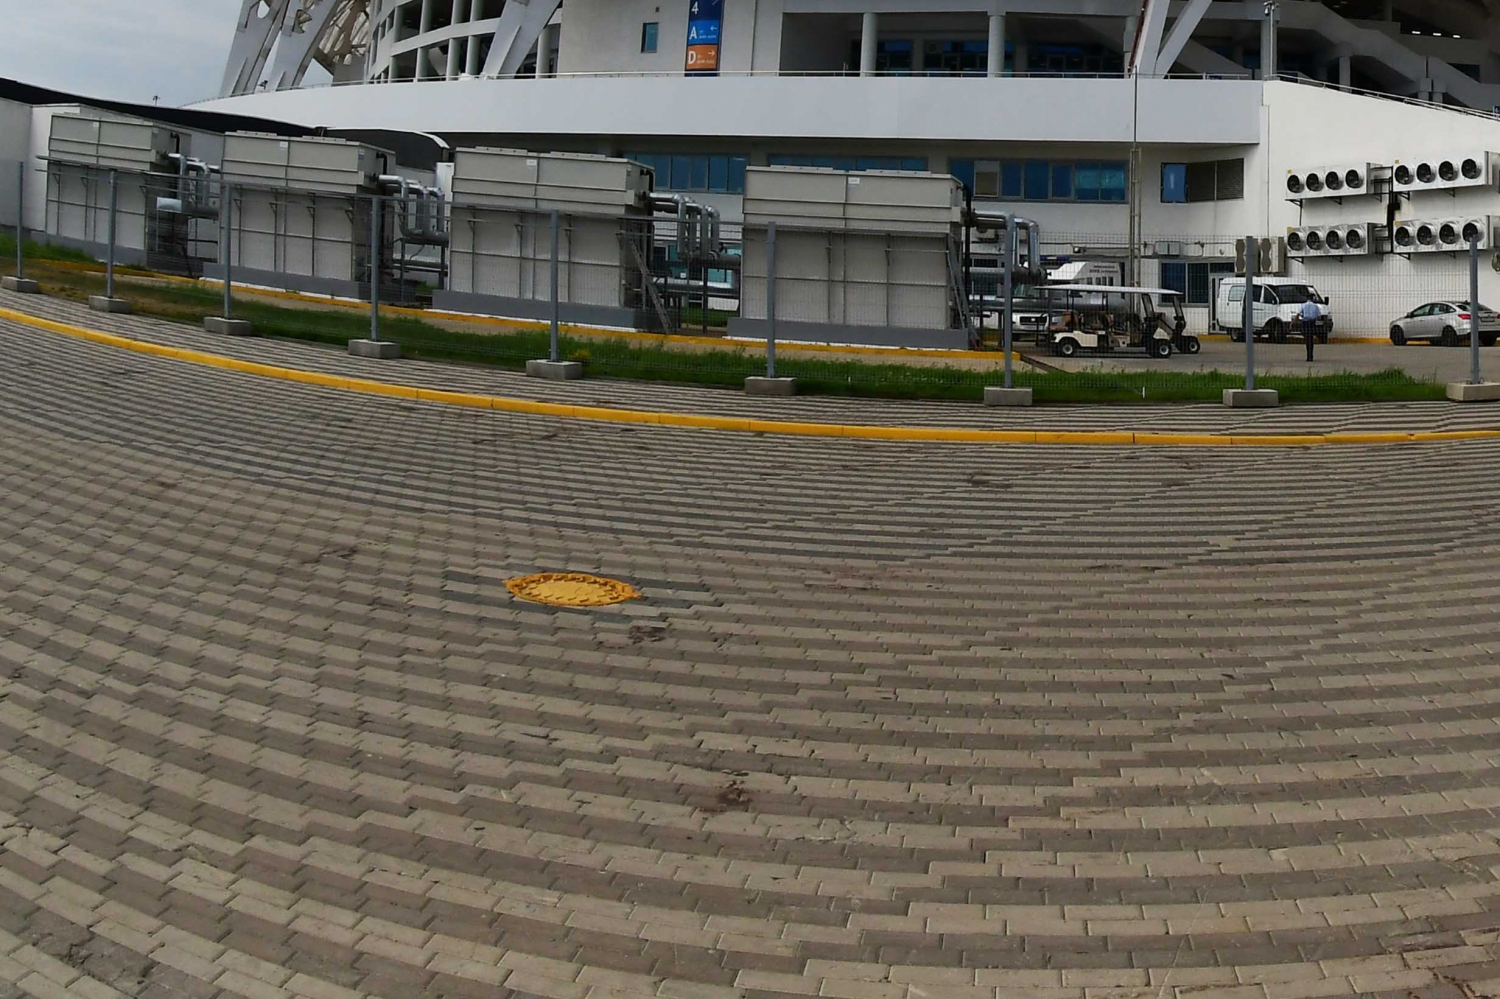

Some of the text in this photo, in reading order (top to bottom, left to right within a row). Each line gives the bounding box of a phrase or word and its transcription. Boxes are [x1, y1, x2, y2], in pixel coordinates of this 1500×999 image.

[691, 1, 699, 15] 4
[689, 25, 698, 40] A
[688, 50, 697, 64] D
